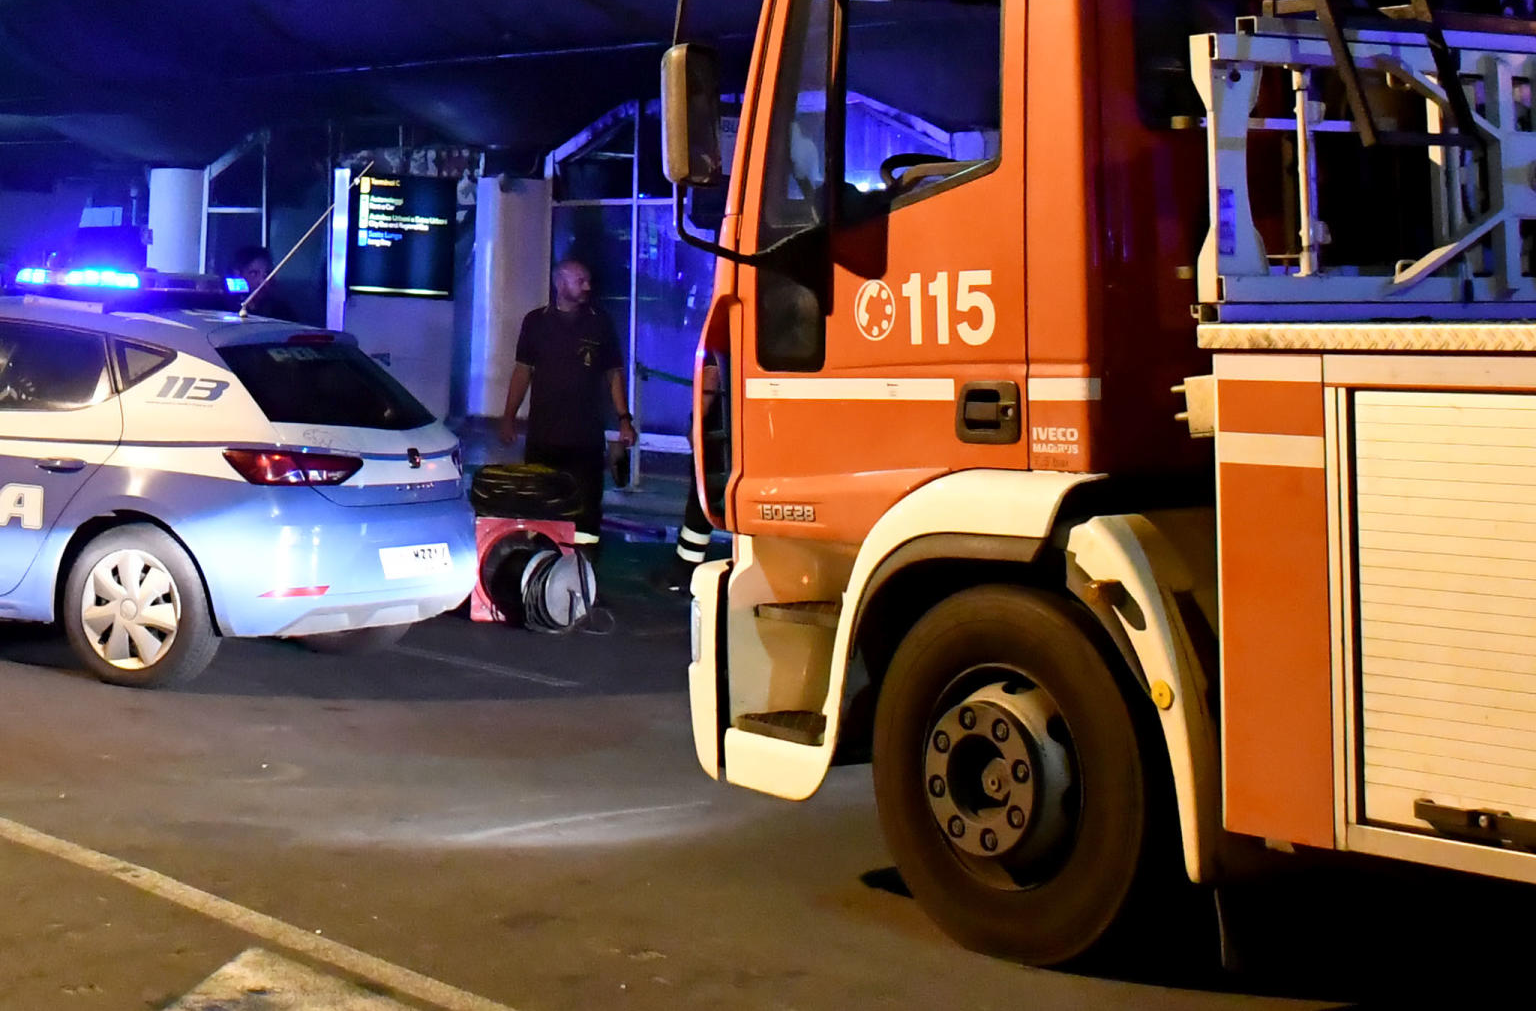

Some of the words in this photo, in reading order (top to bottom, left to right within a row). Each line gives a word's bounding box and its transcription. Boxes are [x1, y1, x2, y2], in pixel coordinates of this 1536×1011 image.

[902, 269, 996, 346] 115
[156, 375, 230, 401] 113
[1032, 426, 1079, 441] IVECO
[757, 504, 816, 522] 150E28
